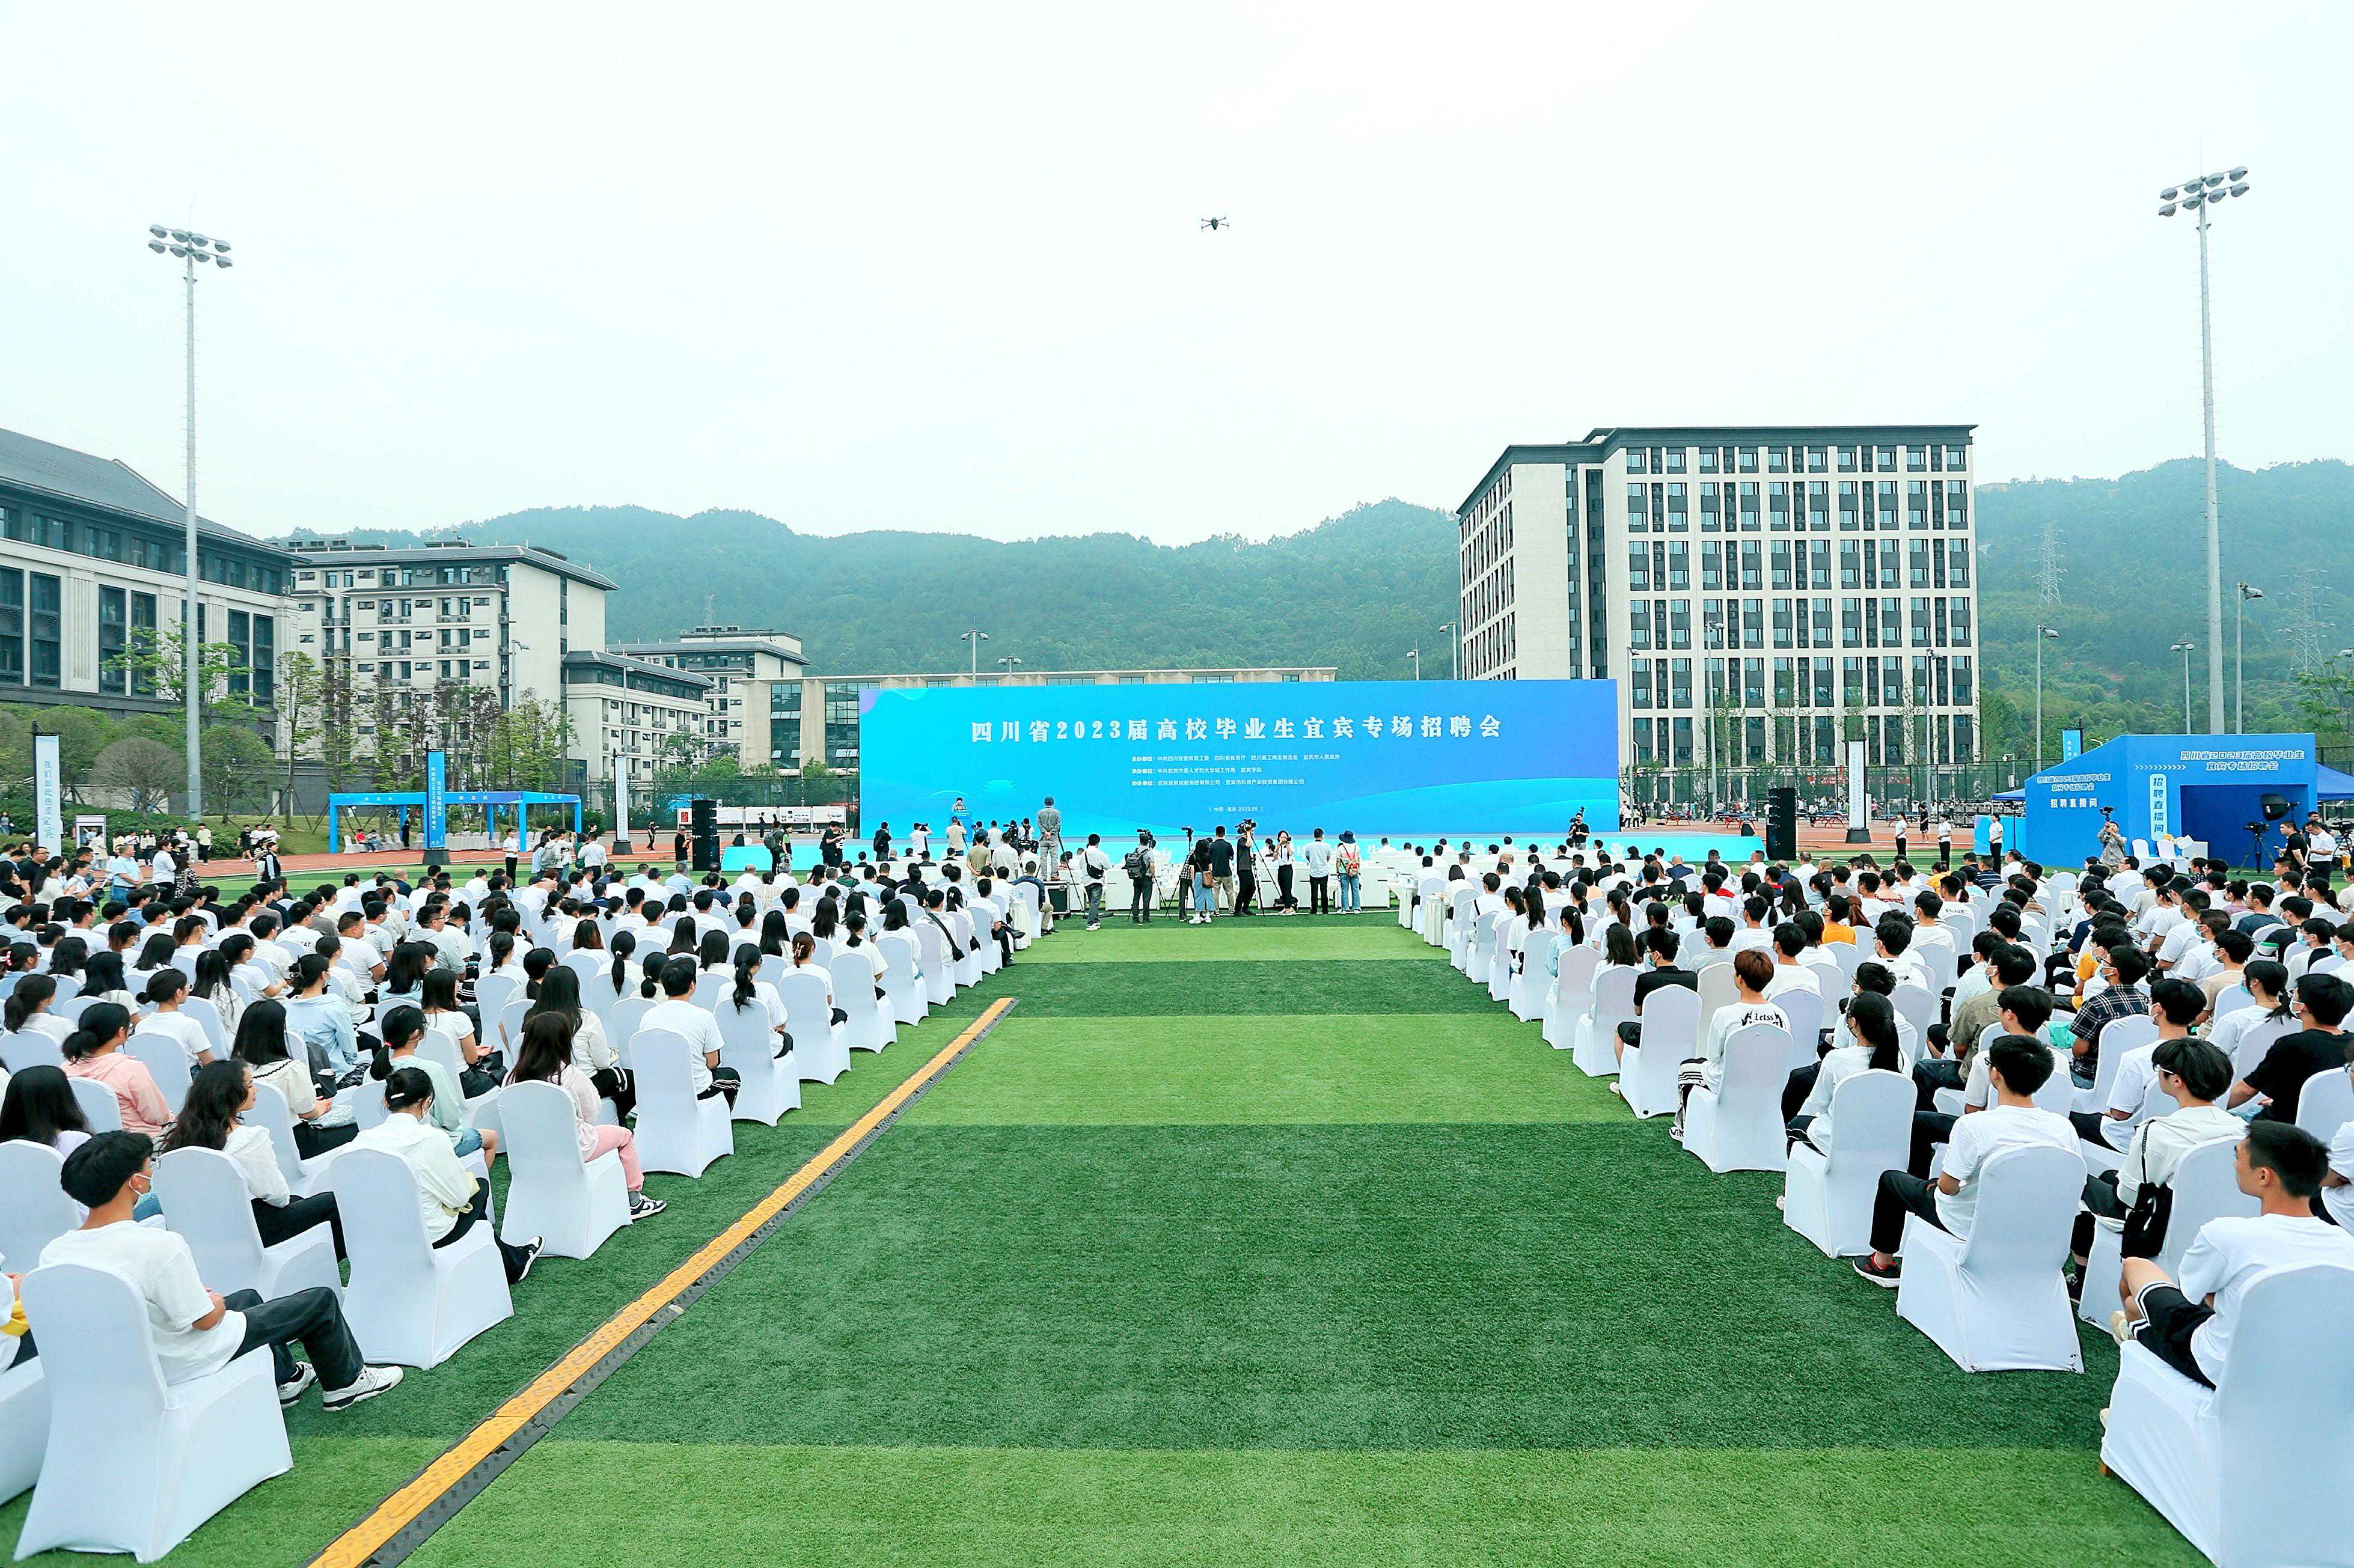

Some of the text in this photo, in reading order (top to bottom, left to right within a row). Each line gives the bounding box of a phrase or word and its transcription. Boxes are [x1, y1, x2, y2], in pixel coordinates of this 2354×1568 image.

[971, 713, 1502, 743] 四川省2023届高校毕业生宜宾专场招聘会
[2180, 750, 2305, 761] 四川省2023届高校毕业生
[2050, 798, 2097, 808] 招聘直播间
[2153, 778, 2164, 833] 招聘直播间
